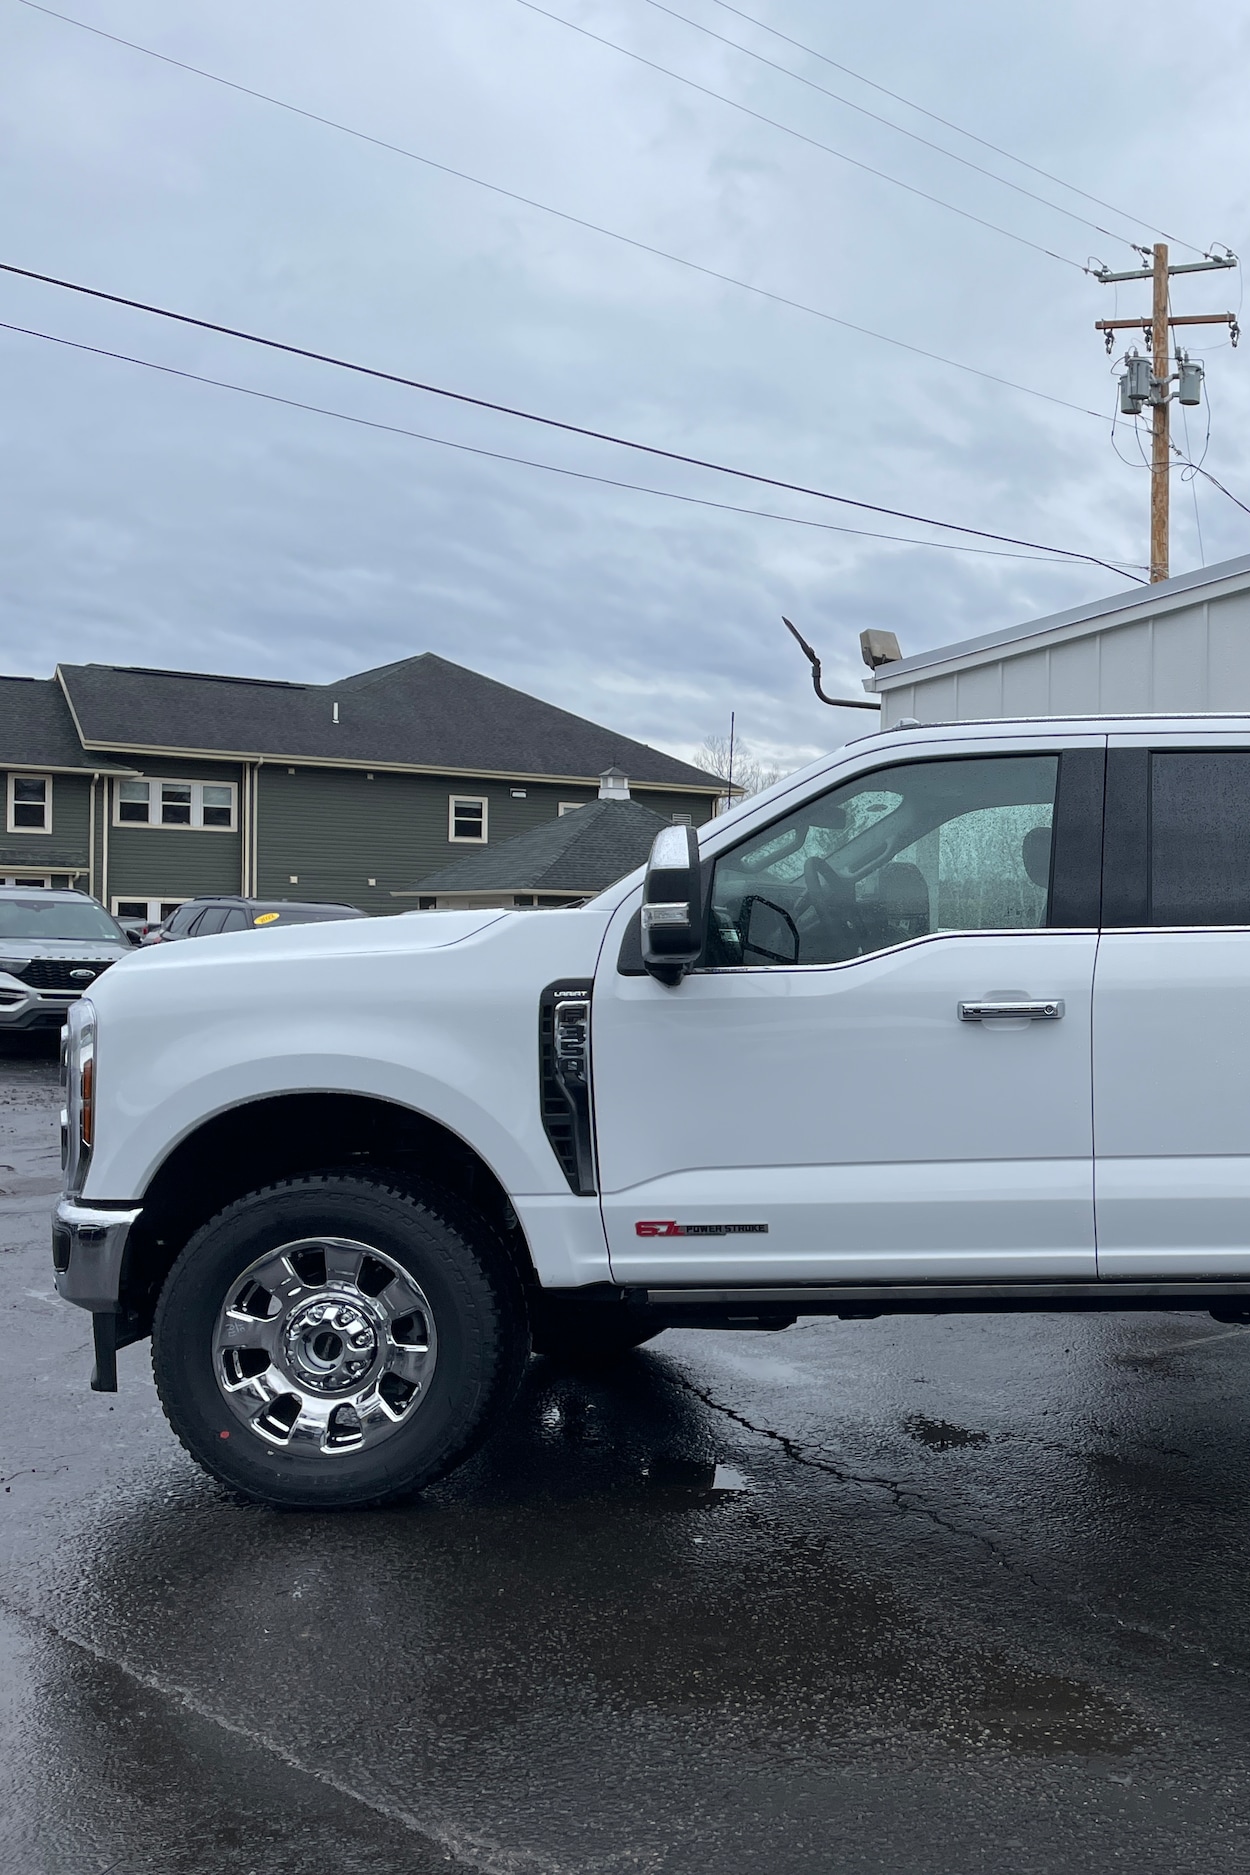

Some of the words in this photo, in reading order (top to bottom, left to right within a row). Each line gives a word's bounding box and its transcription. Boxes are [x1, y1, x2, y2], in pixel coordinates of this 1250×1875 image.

[553, 990, 588, 998] LARIAT
[686, 1224, 722, 1233] POWER
[725, 1223, 766, 1233] STROKE
